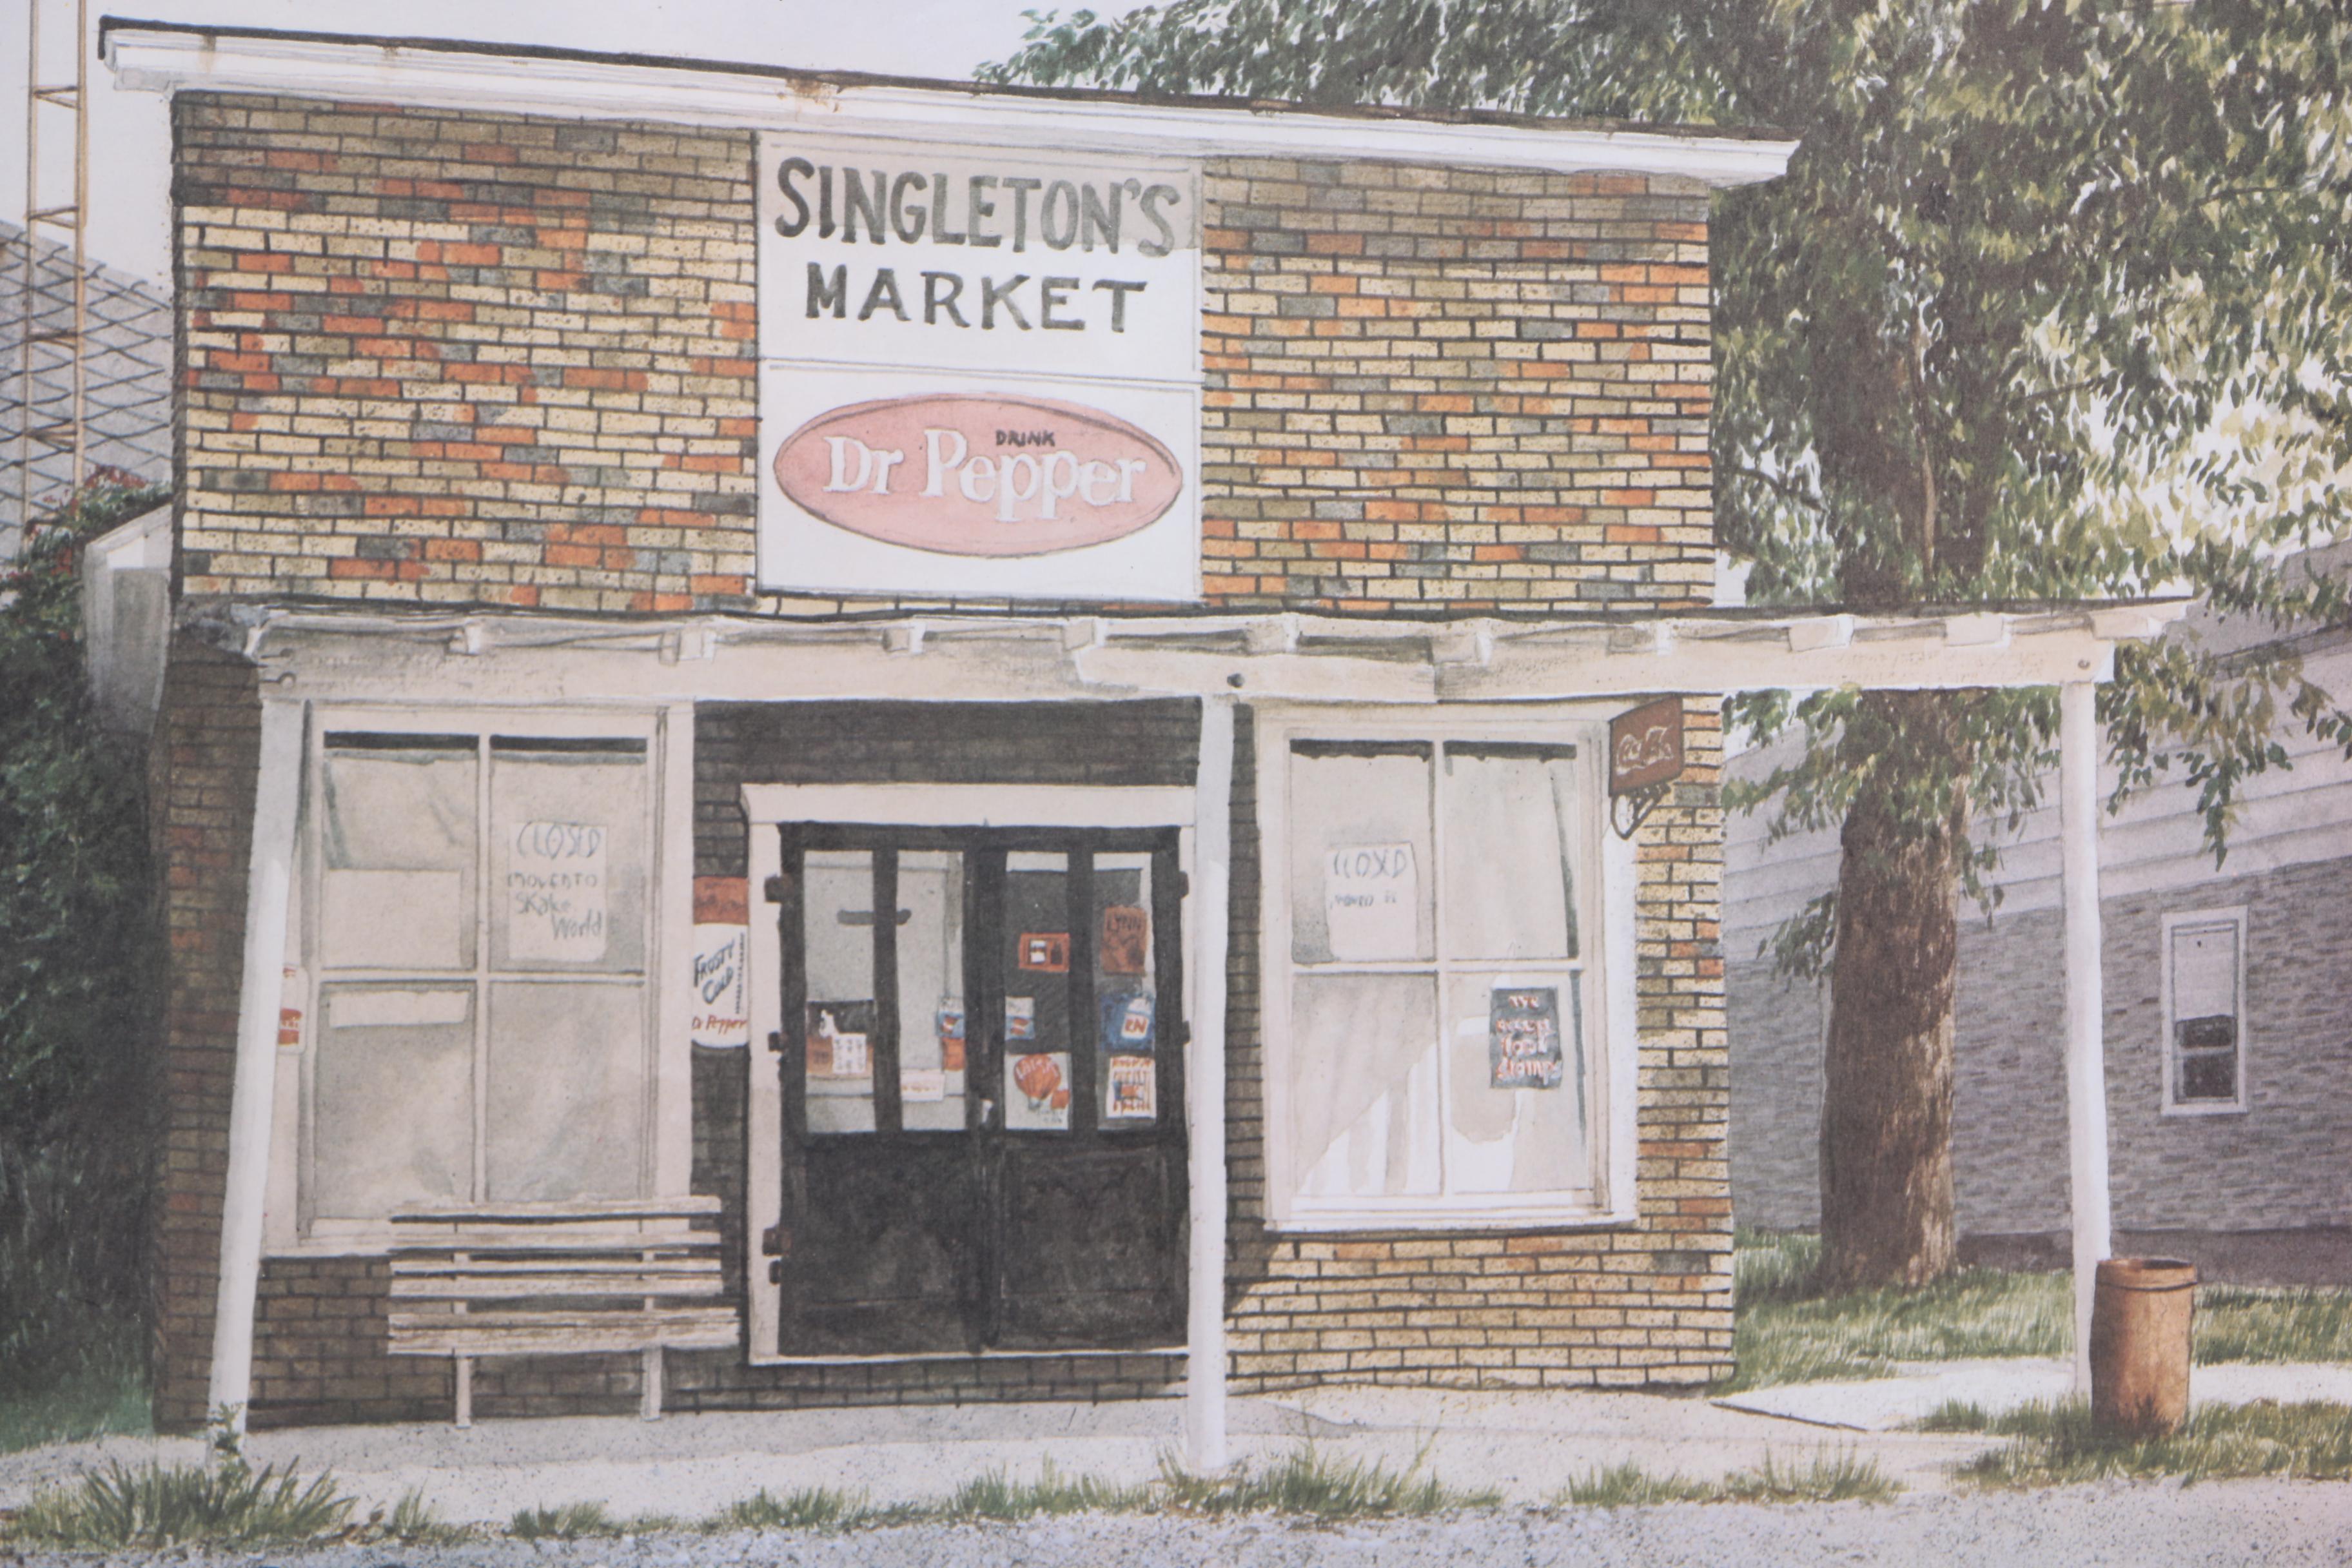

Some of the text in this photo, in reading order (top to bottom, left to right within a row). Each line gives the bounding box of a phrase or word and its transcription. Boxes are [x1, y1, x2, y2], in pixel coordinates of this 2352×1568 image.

[774, 157, 1181, 257] SINGLETON'S
[805, 262, 1148, 333] MARKET
[823, 427, 1147, 523] Dr Pepper
[995, 429, 1056, 447] DRINK
